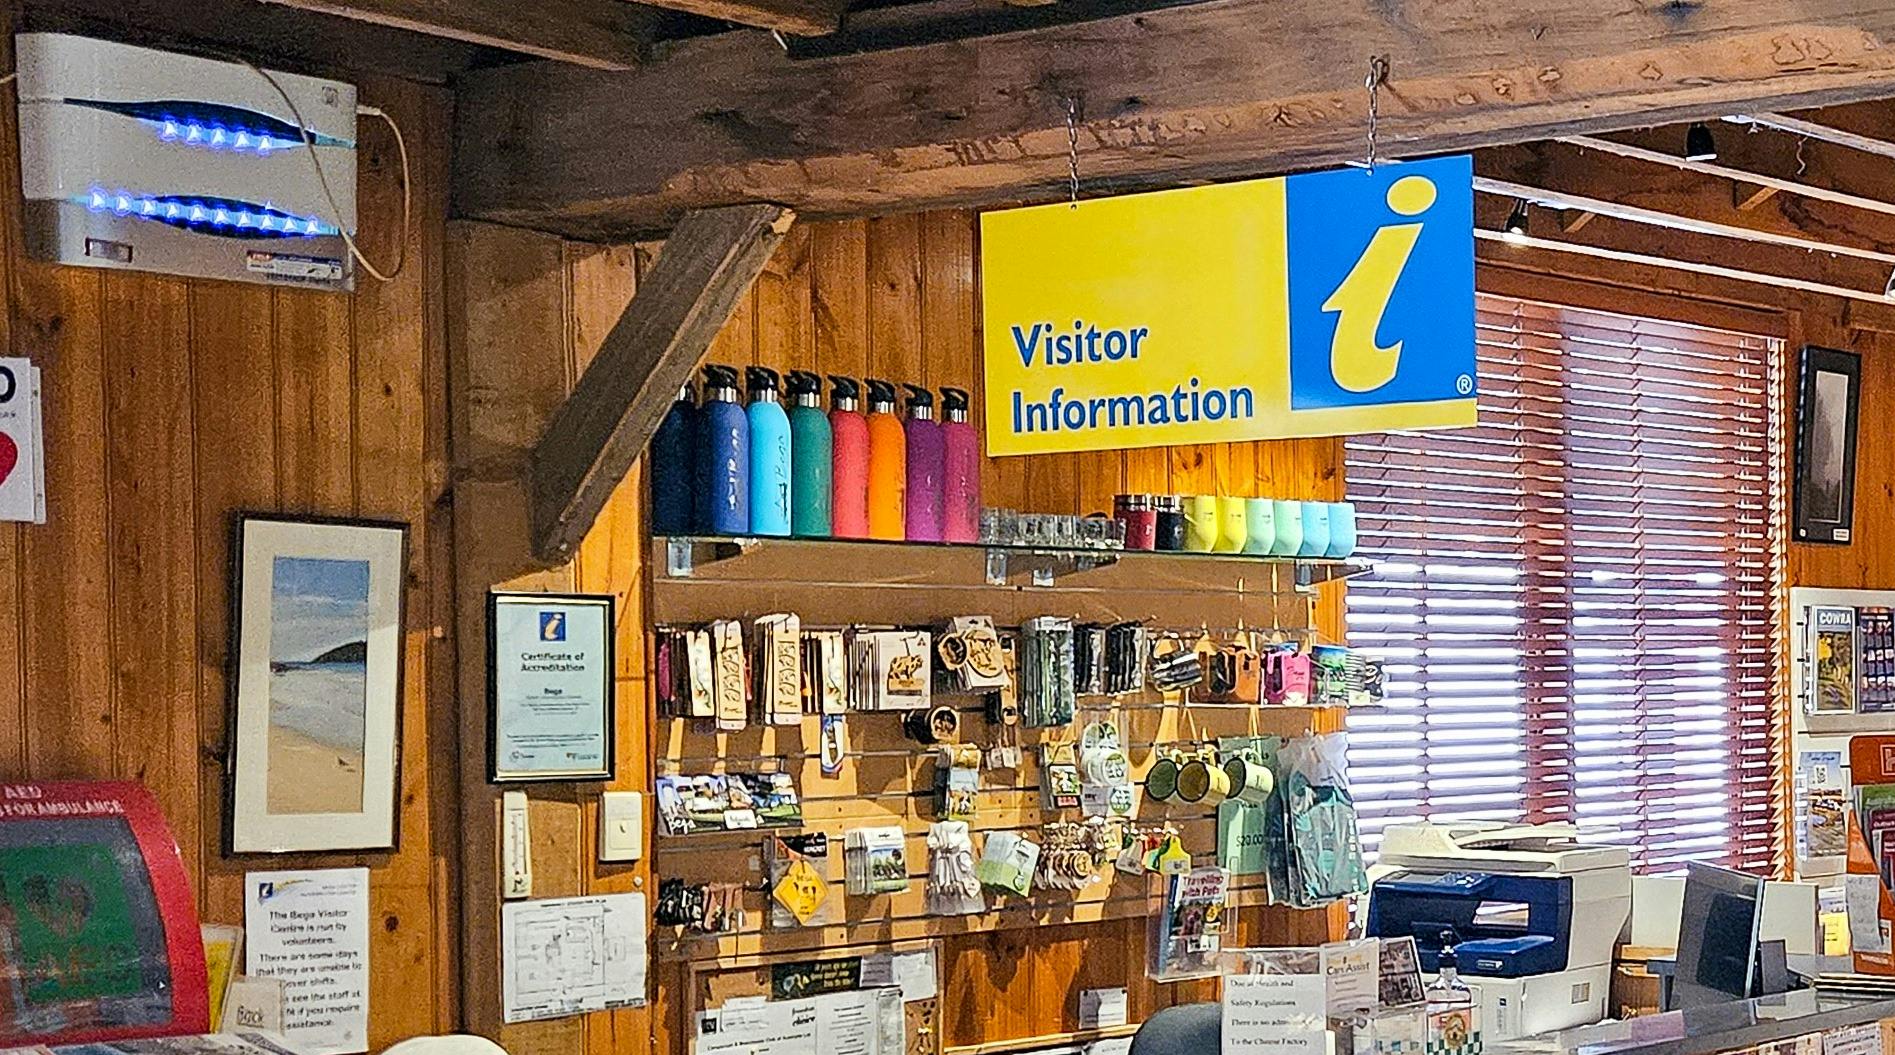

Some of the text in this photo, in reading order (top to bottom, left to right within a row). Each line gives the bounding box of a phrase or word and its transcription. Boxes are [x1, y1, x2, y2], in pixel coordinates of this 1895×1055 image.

[1011, 321, 1148, 368] Visitor
[1012, 378, 1254, 433] Information
[1819, 611, 1852, 625] COWRA
[38, 800, 125, 815] AMBULANCE
[1230, 999, 1253, 1008] Safety
